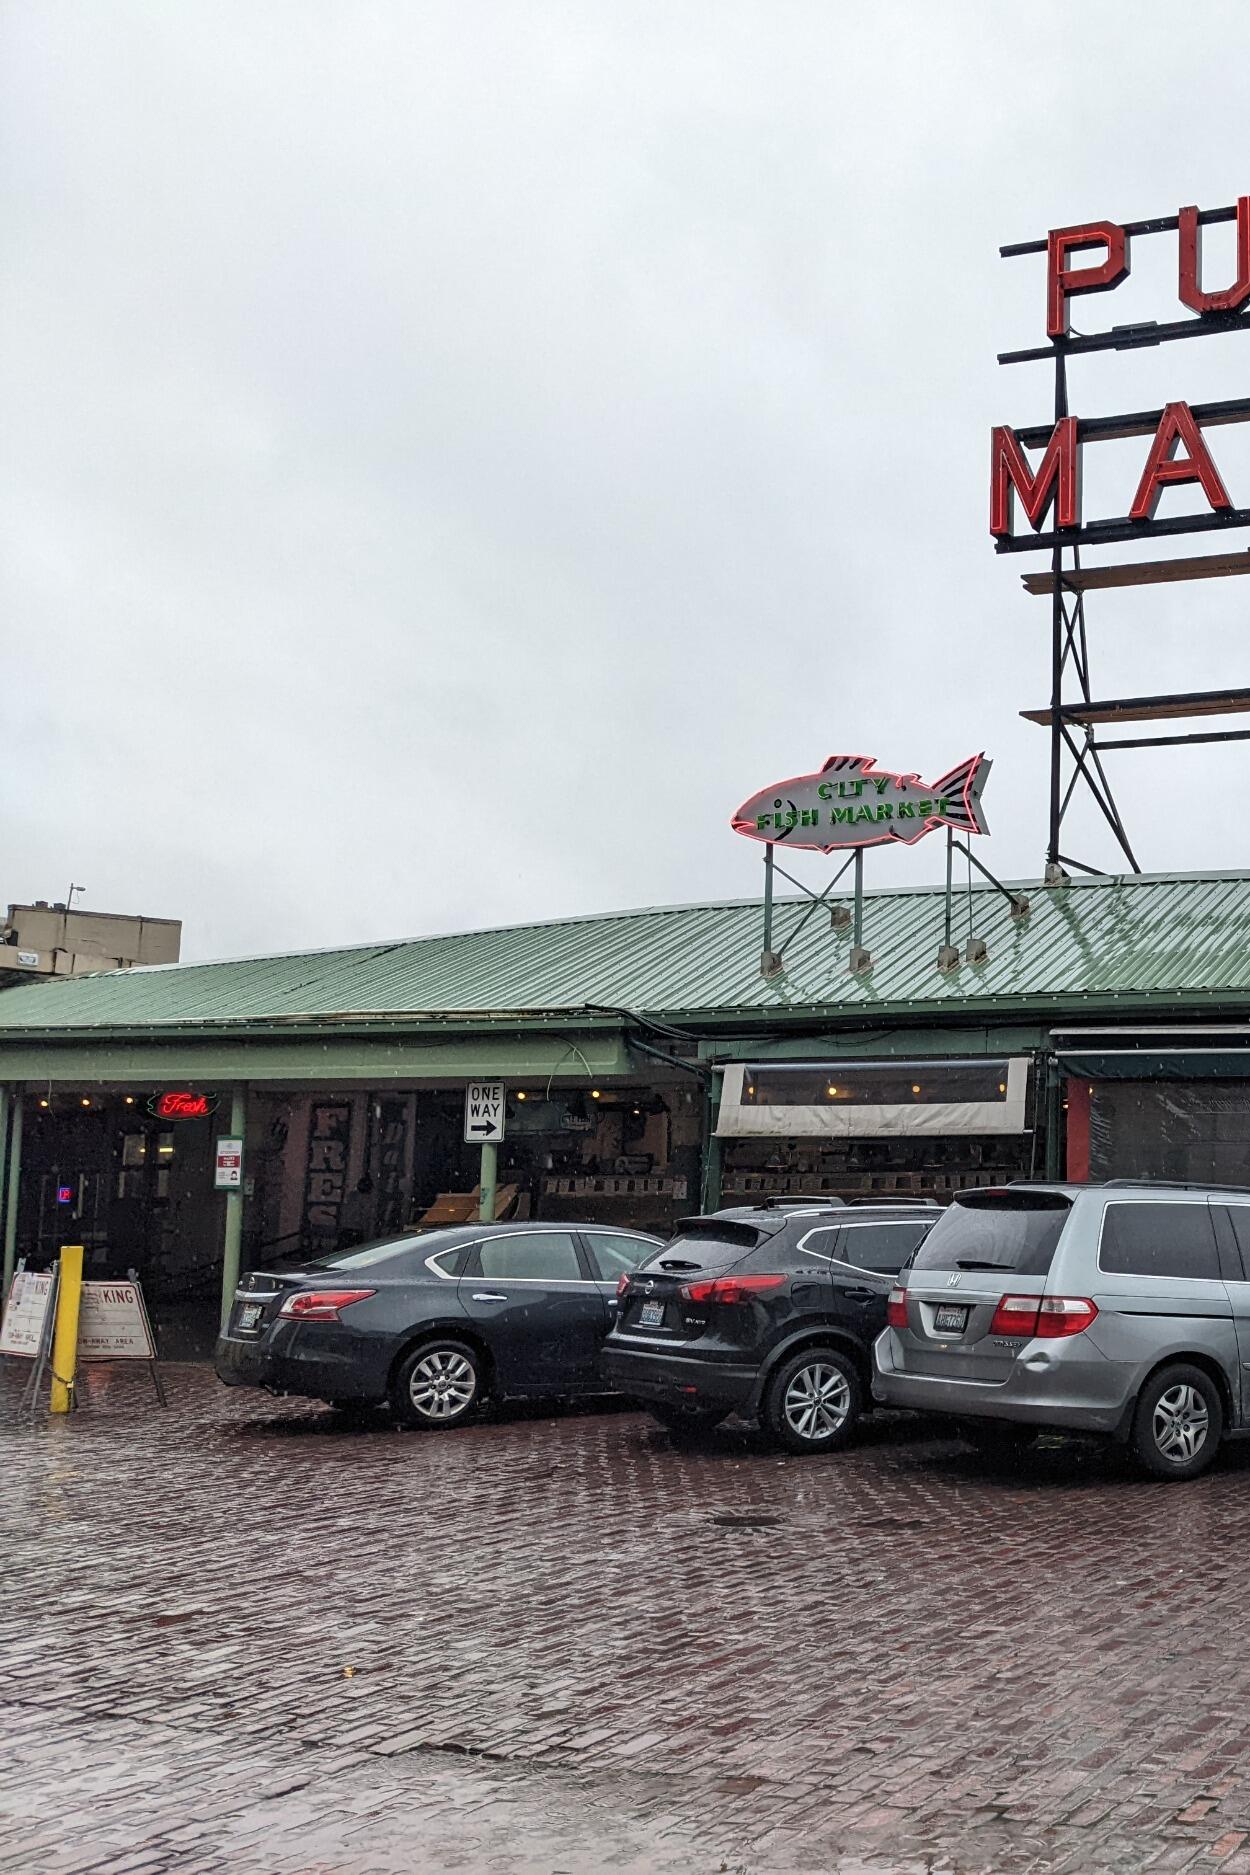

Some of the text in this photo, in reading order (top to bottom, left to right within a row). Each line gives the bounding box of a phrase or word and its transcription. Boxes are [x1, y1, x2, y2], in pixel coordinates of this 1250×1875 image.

[817, 776, 891, 801] CITY
[757, 797, 951, 830] FISH MARKET
[471, 1086, 500, 1101] ONE
[163, 1093, 208, 1114] Fresh
[470, 1103, 501, 1118] WAY
[103, 1289, 134, 1304] KING
[78, 1337, 109, 1345] OW-AWAY
